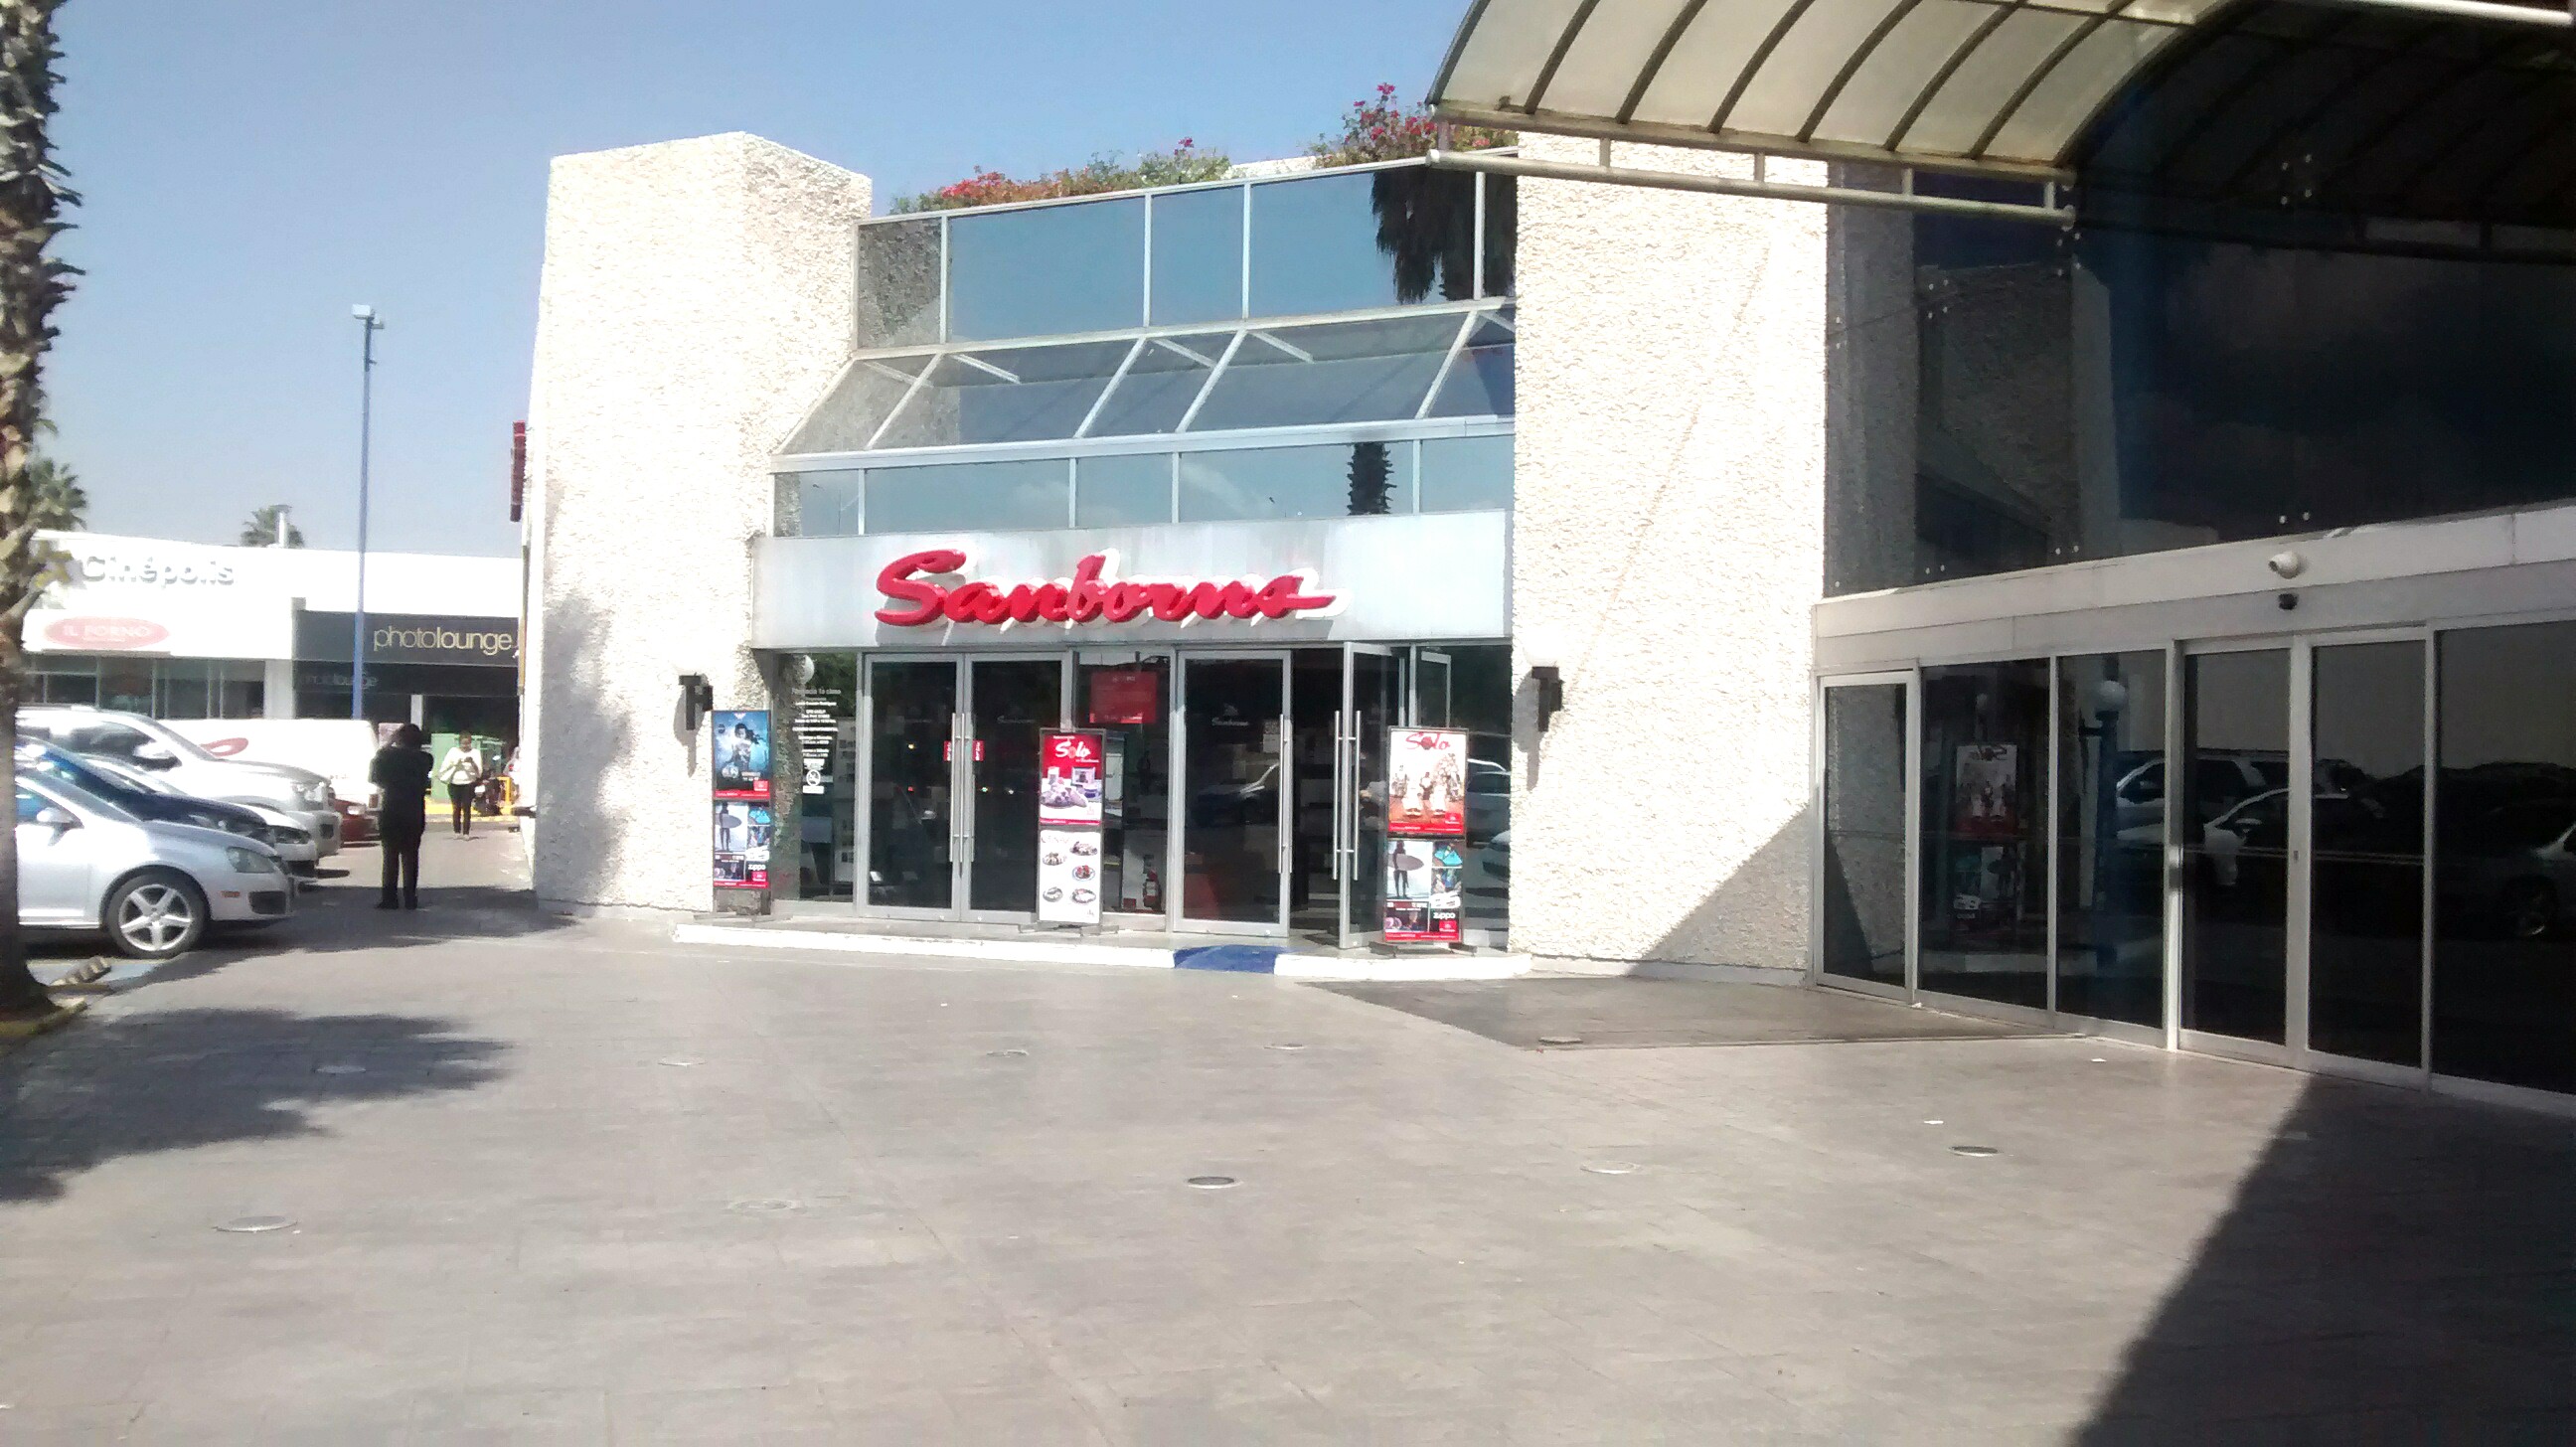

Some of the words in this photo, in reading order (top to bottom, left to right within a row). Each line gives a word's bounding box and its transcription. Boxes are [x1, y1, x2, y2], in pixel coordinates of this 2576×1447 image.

[83, 556, 235, 589] Cinépolis
[875, 549, 1340, 626] Sanborns
[373, 625, 513, 656] photolounge
